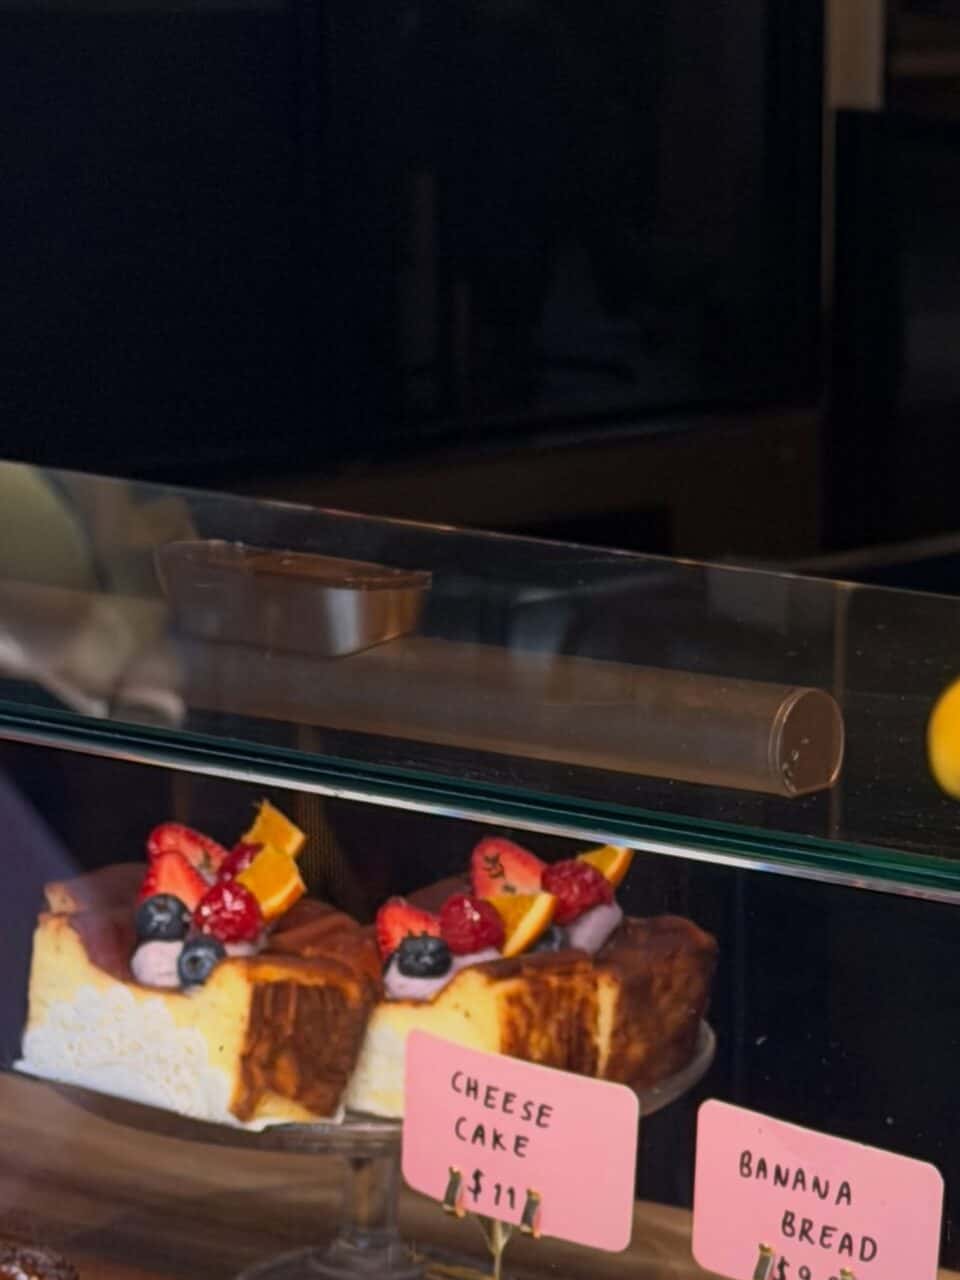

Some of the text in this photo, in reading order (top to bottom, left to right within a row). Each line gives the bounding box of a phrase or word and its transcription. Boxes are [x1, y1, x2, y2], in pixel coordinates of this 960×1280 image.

[451, 1071, 554, 1128] CHEESE
[454, 1116, 529, 1158] CAKE
[468, 1169, 515, 1209] $11
[739, 1150, 852, 1206] BANANA
[782, 1210, 878, 1262] BREAD
